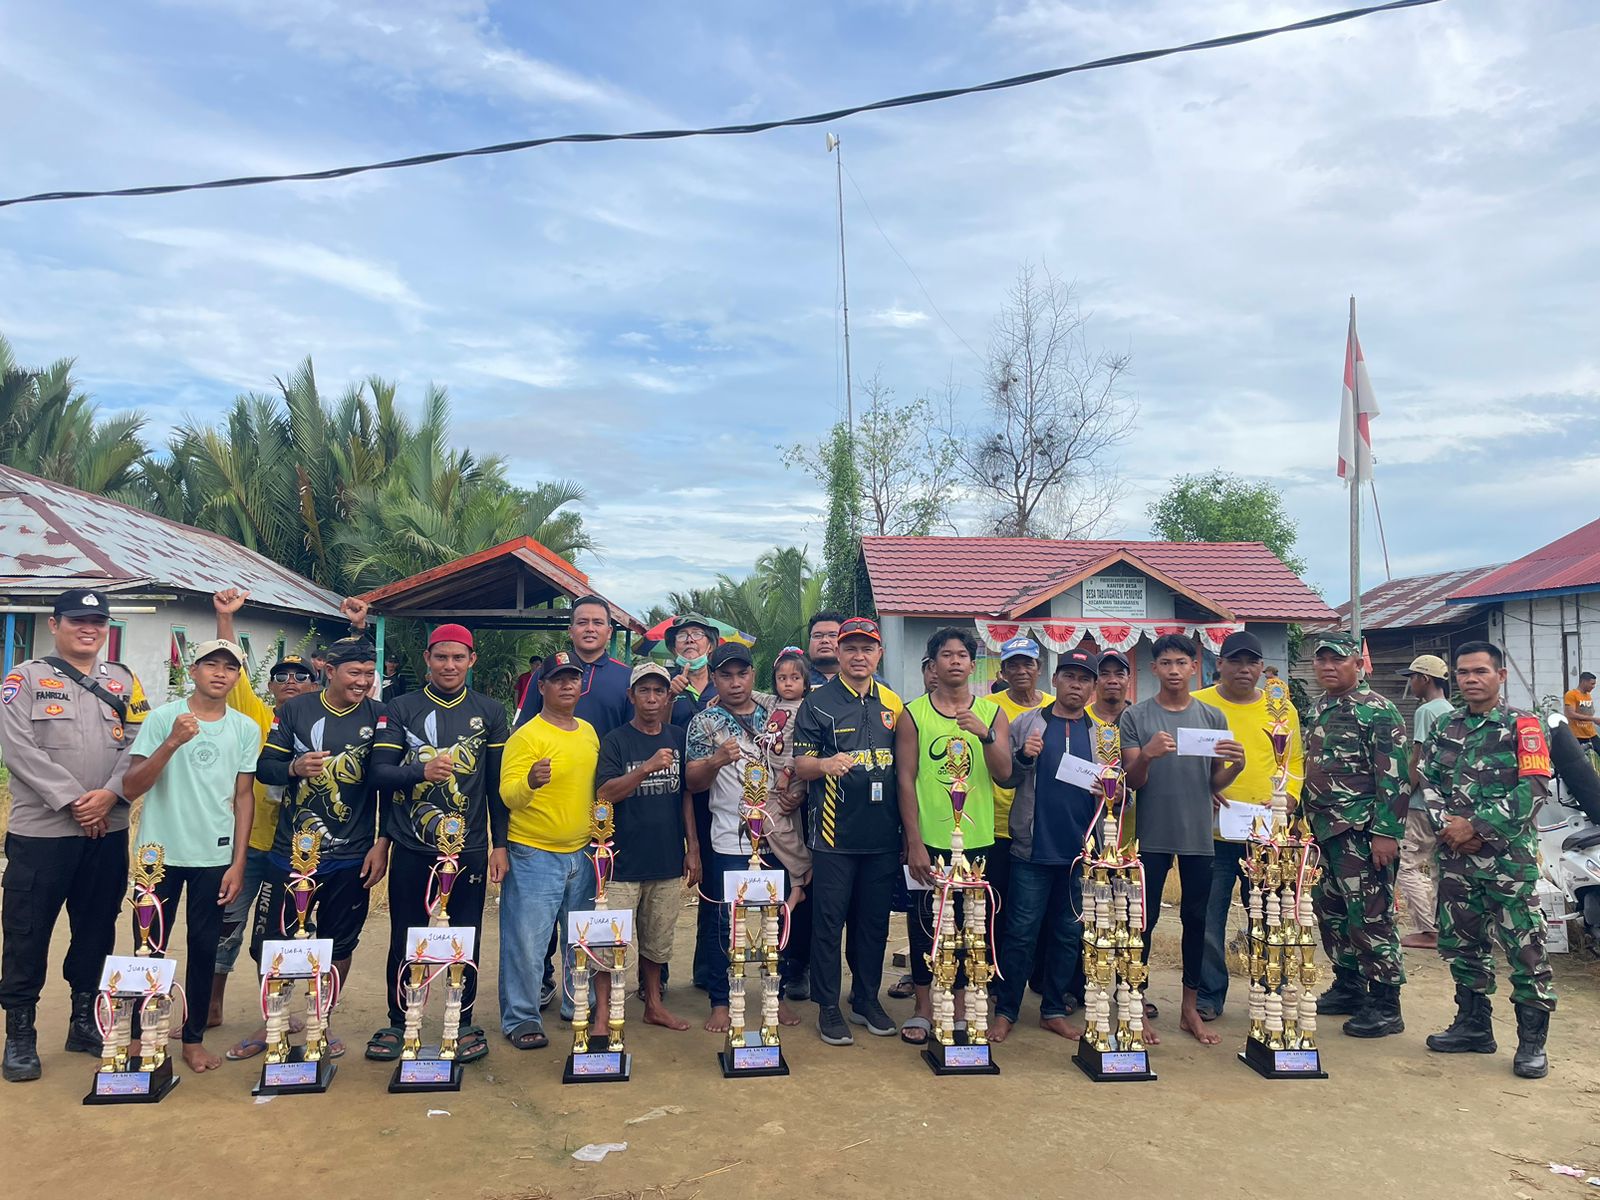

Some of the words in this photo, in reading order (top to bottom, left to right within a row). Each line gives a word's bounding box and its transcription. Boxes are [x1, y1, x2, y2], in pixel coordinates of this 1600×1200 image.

[1086, 589, 1096, 599] DESA
[36, 691, 71, 701] FAHRIZAL
[260, 881, 273, 913] NIKE
